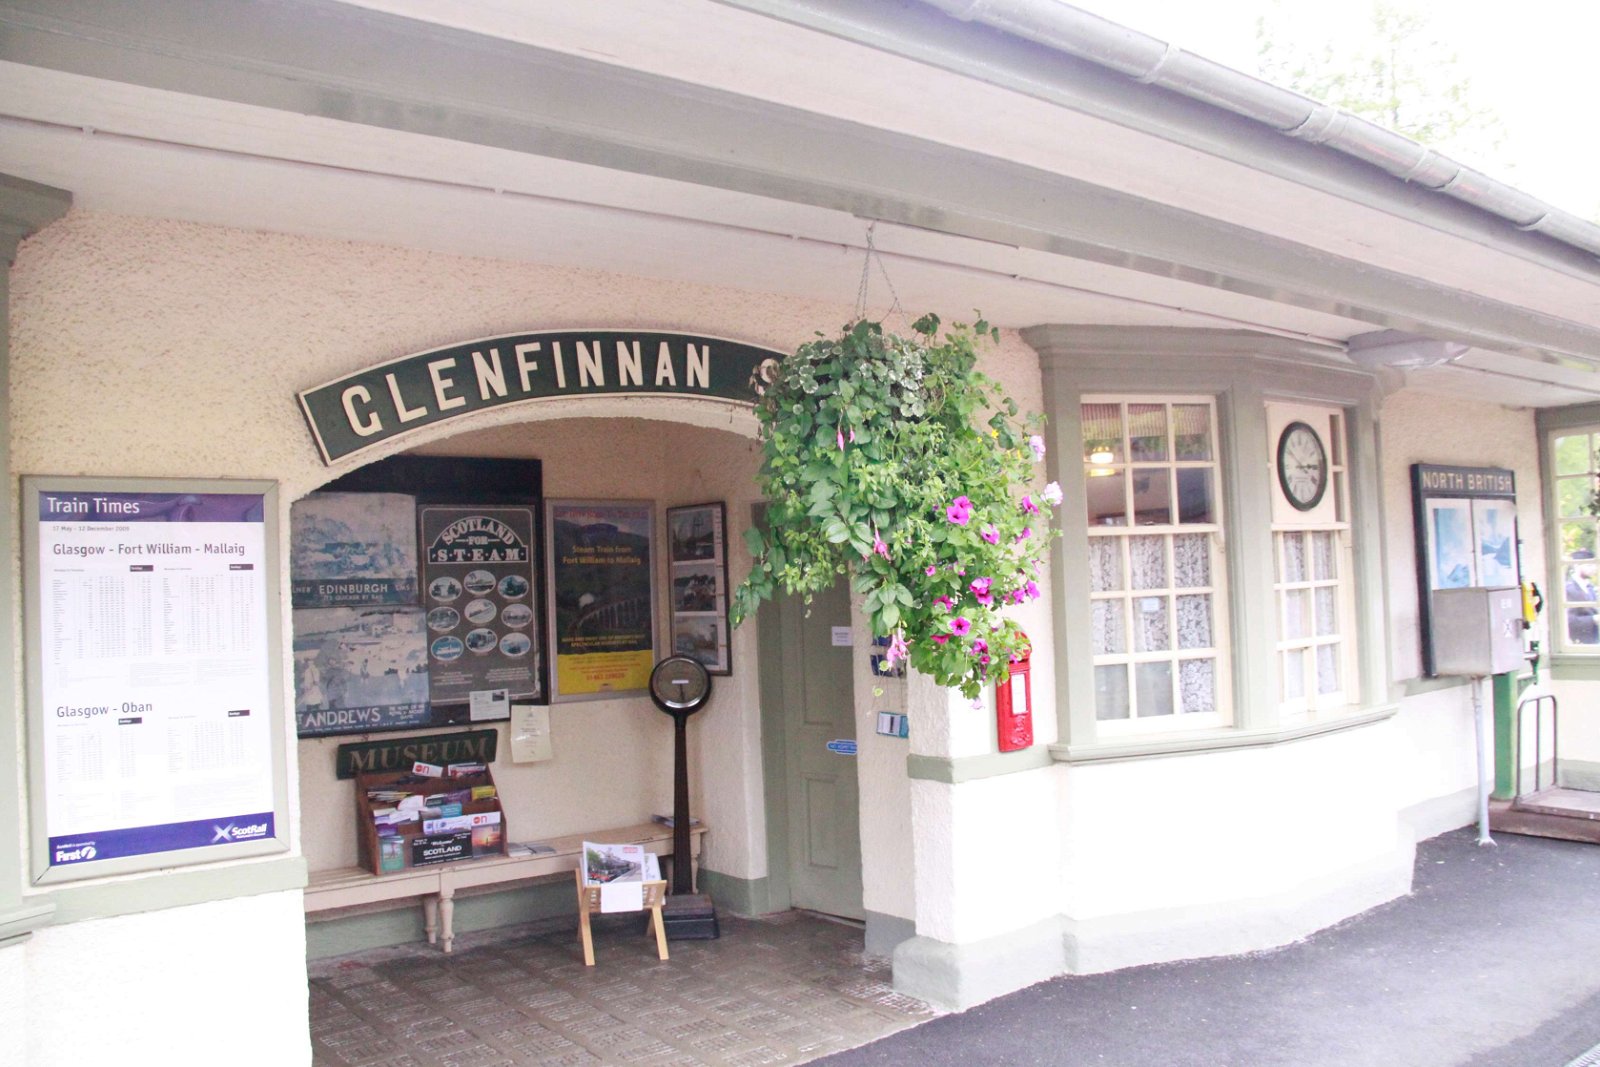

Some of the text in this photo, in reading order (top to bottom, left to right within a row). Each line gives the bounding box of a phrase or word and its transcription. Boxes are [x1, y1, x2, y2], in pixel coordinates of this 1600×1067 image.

[341, 340, 710, 438] GLENFINNAN
[1422, 472, 1512, 491] NORTH BRITISH
[47, 497, 140, 514] Train Times
[442, 518, 515, 545] SCOTLAND
[468, 536, 489, 545] FOR
[53, 543, 106, 558] Glasgow
[118, 543, 143, 555] Fort
[146, 543, 192, 555] William
[204, 542, 245, 557] Mallaig
[319, 583, 388, 595] EDINBURGH
[56, 703, 109, 719] Glasgow
[122, 701, 153, 714] Oban
[305, 707, 381, 728] ANDREWS
[351, 737, 487, 771] MUSEUM
[231, 823, 268, 836] ScotRail
[56, 849, 81, 863] First
[423, 845, 463, 856] SCOTLAND
